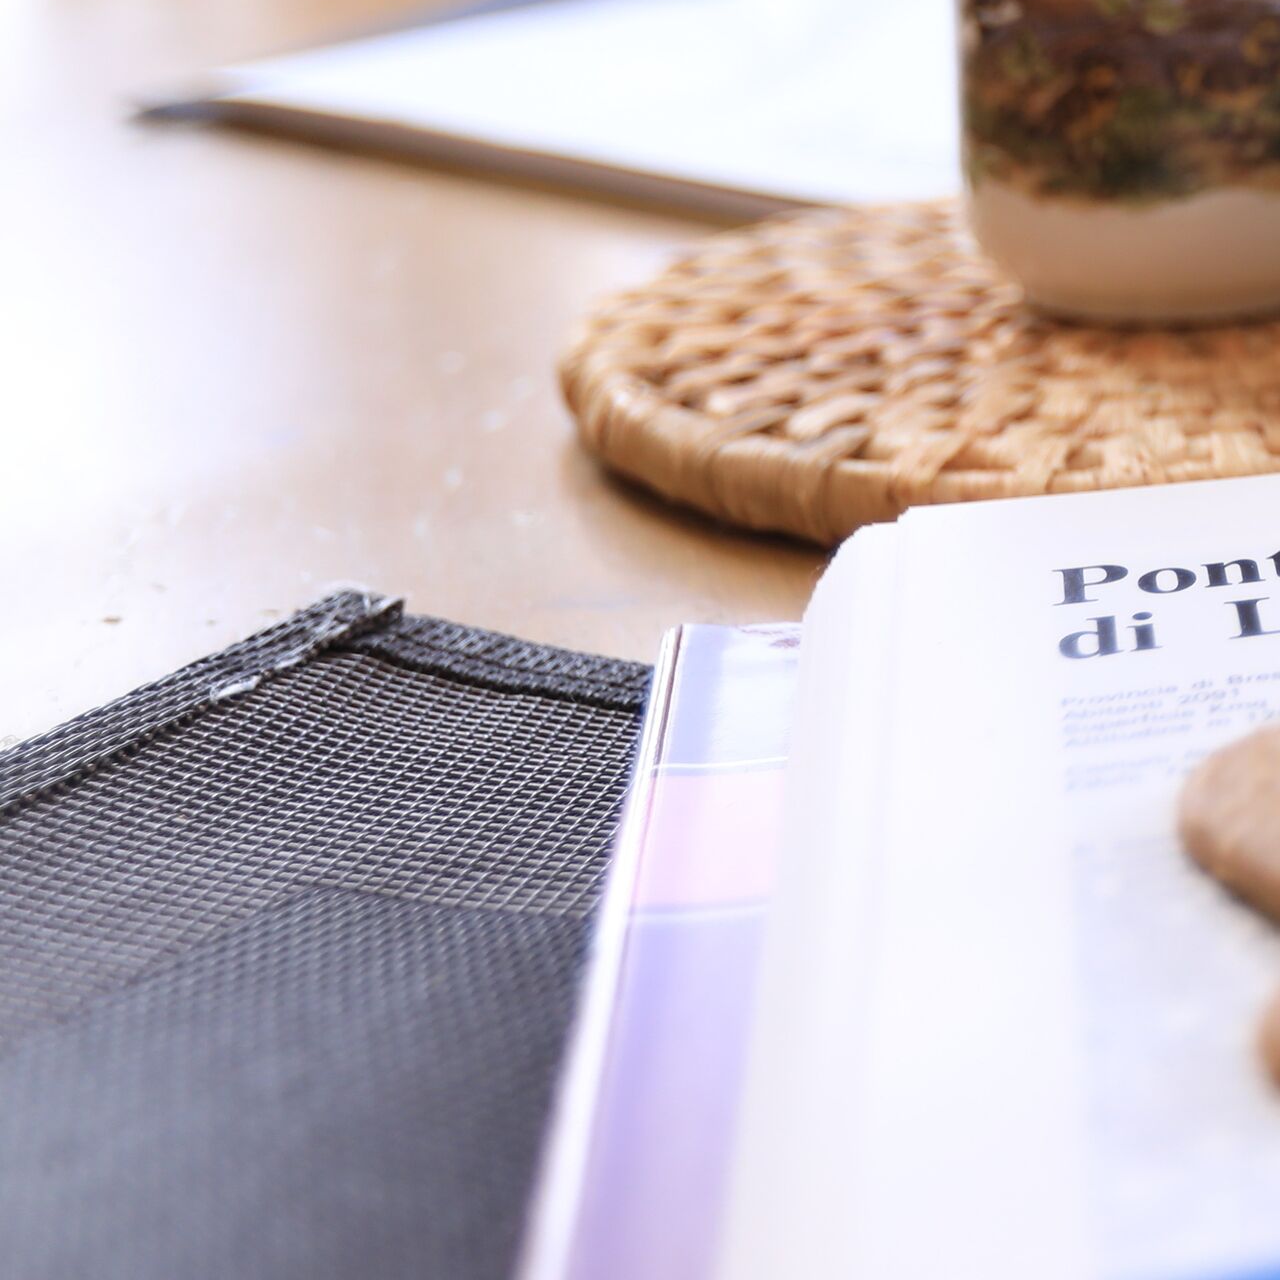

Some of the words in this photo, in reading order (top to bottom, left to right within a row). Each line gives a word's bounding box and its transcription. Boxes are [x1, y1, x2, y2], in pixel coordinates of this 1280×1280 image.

[1057, 610, 1164, 661] di
[1060, 682, 1179, 709] Provincia
[1191, 678, 1213, 691] di
